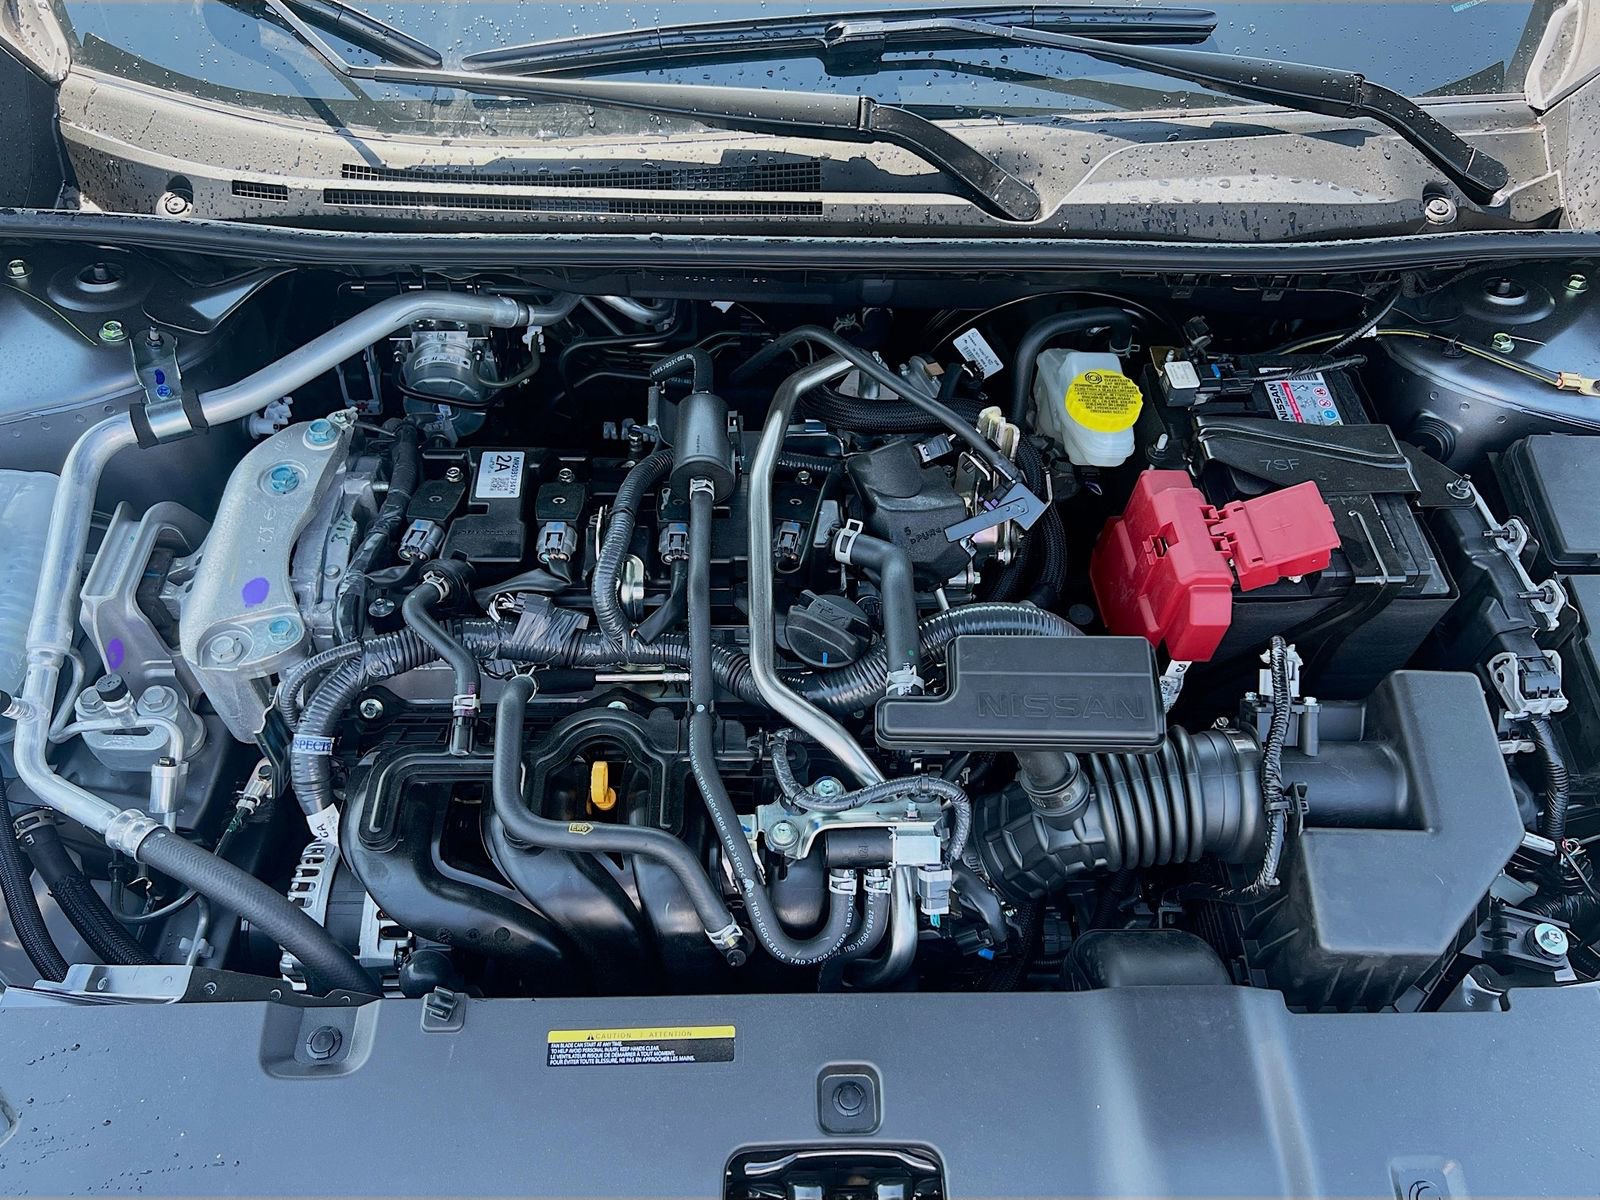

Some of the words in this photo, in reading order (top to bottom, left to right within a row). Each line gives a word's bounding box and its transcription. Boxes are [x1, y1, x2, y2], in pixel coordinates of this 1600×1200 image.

[1268, 383, 1289, 420] NISSAN
[494, 454, 513, 473] 2A
[977, 691, 1146, 719] NISSAN
[595, 1032, 632, 1040] CAUTION
[648, 1030, 692, 1038] ATTENTION
